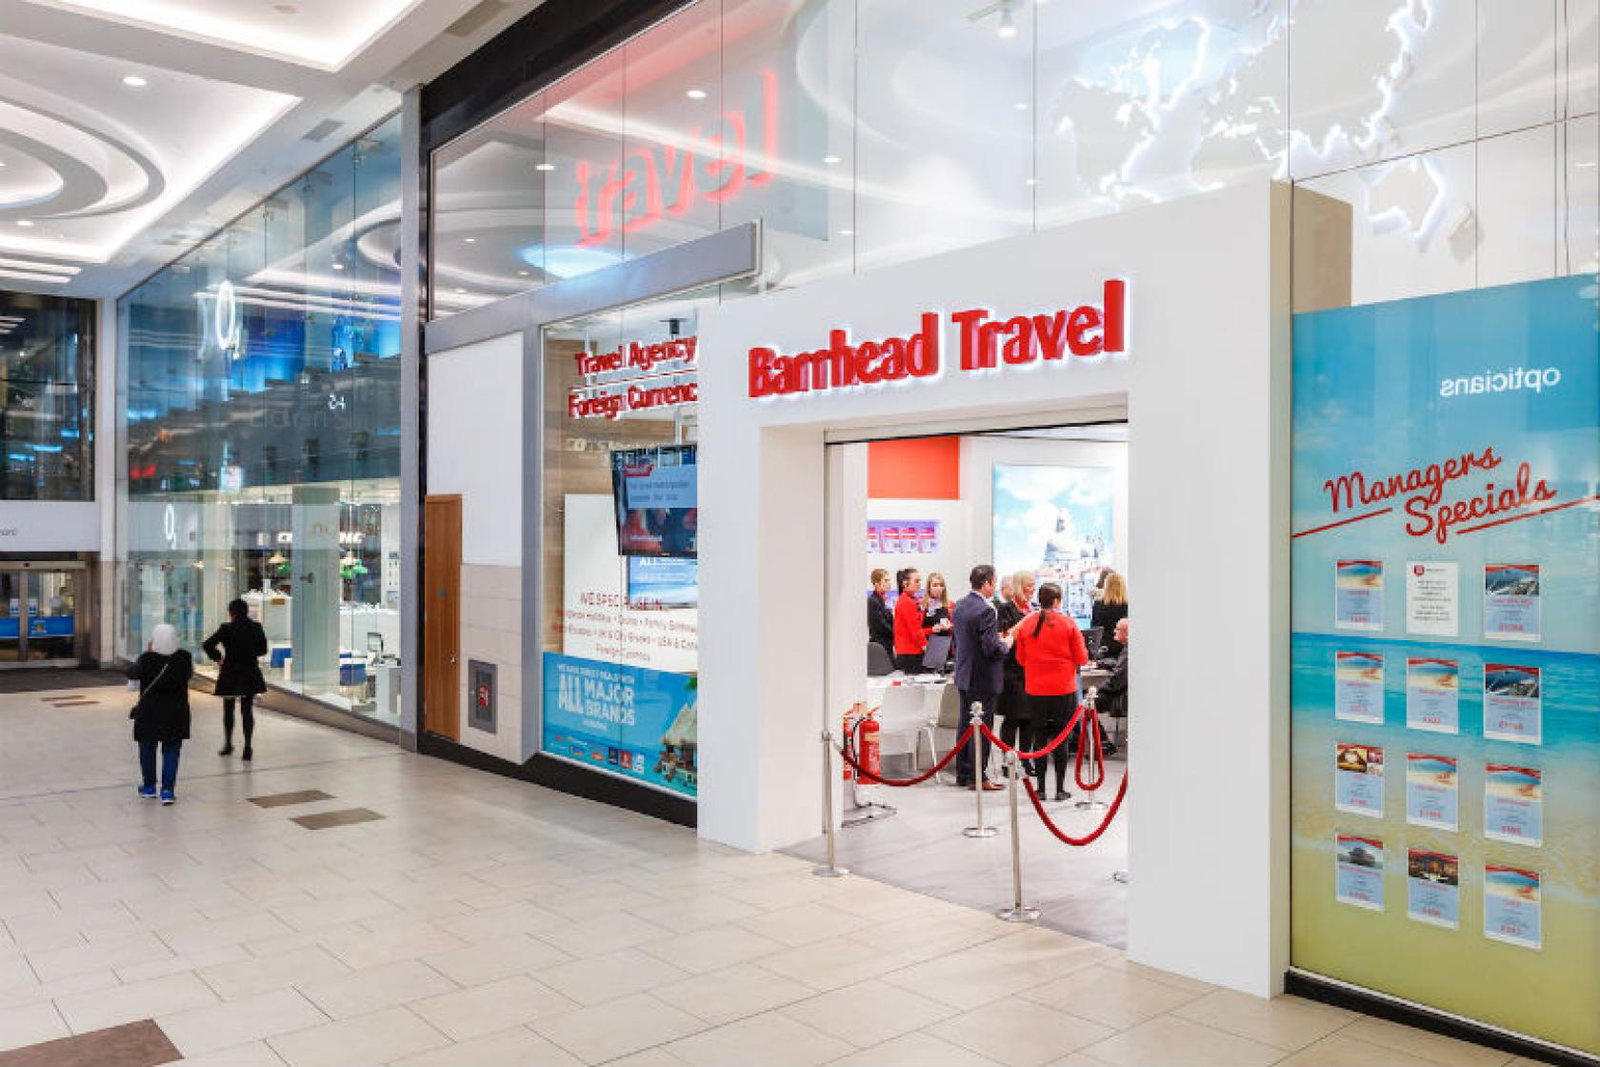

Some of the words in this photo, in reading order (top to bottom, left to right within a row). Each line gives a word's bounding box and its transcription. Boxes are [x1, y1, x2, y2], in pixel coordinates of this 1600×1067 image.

[575, 345, 625, 376] Travel
[629, 336, 697, 371] Agency
[748, 312, 939, 398] Barrhead
[951, 279, 1125, 371] Travel
[568, 390, 627, 419] Foreign
[1324, 446, 1502, 513] Managers
[1404, 462, 1558, 544] Specials
[584, 677, 635, 707] MAJOR
[586, 700, 636, 727] BRANDS
